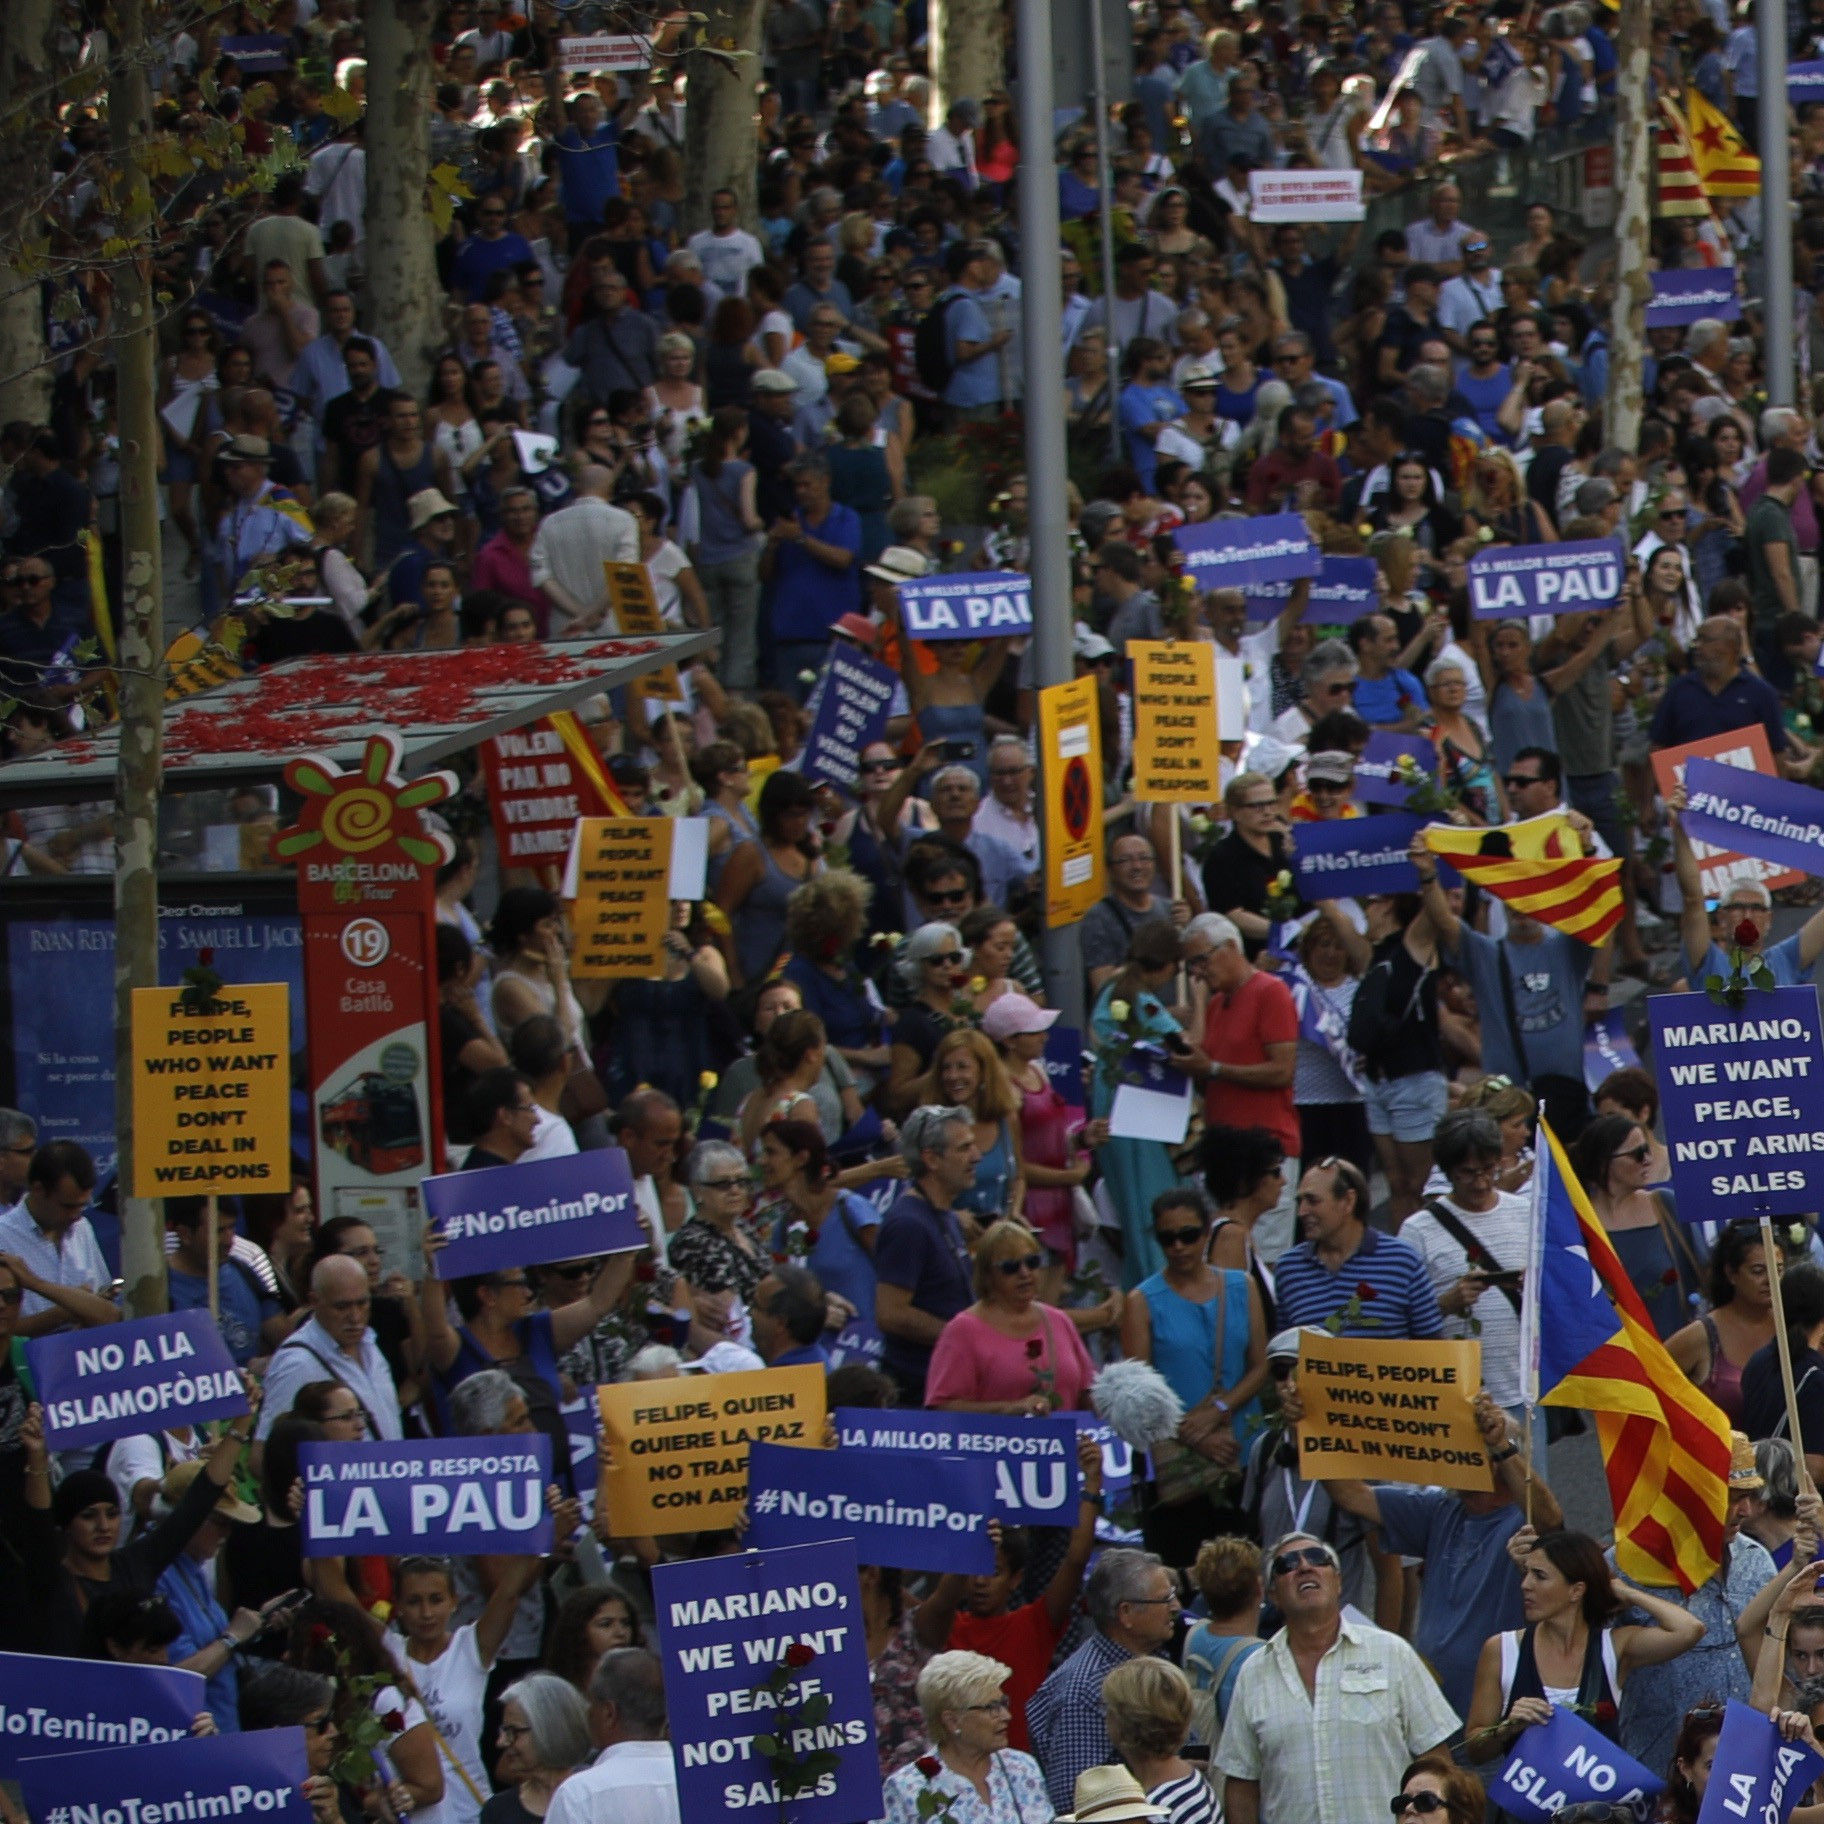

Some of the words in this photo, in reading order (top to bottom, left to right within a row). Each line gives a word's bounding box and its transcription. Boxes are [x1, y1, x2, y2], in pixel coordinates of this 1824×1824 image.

[307, 863, 420, 881] BARCELONA
[348, 930, 381, 958] 19
[345, 977, 386, 994] Casa
[167, 1027, 254, 1046] PEOPLE
[1663, 1018, 1811, 1048] MARIANO,
[144, 1057, 201, 1074] WHO
[206, 1054, 277, 1072] WANT
[1670, 1063, 1717, 1086] WE
[1723, 1056, 1812, 1081] WANT
[174, 1083, 249, 1100] PEACE
[176, 1110, 247, 1128] DON'T
[1694, 1096, 1800, 1123] PEACE,
[167, 1138, 228, 1155] DEAL
[232, 1137, 256, 1152] IN
[1675, 1138, 1736, 1162] NOT
[154, 1163, 270, 1182] WEAPONS
[1711, 1170, 1806, 1196] SALES
[443, 1192, 629, 1240] #NoTenimPor
